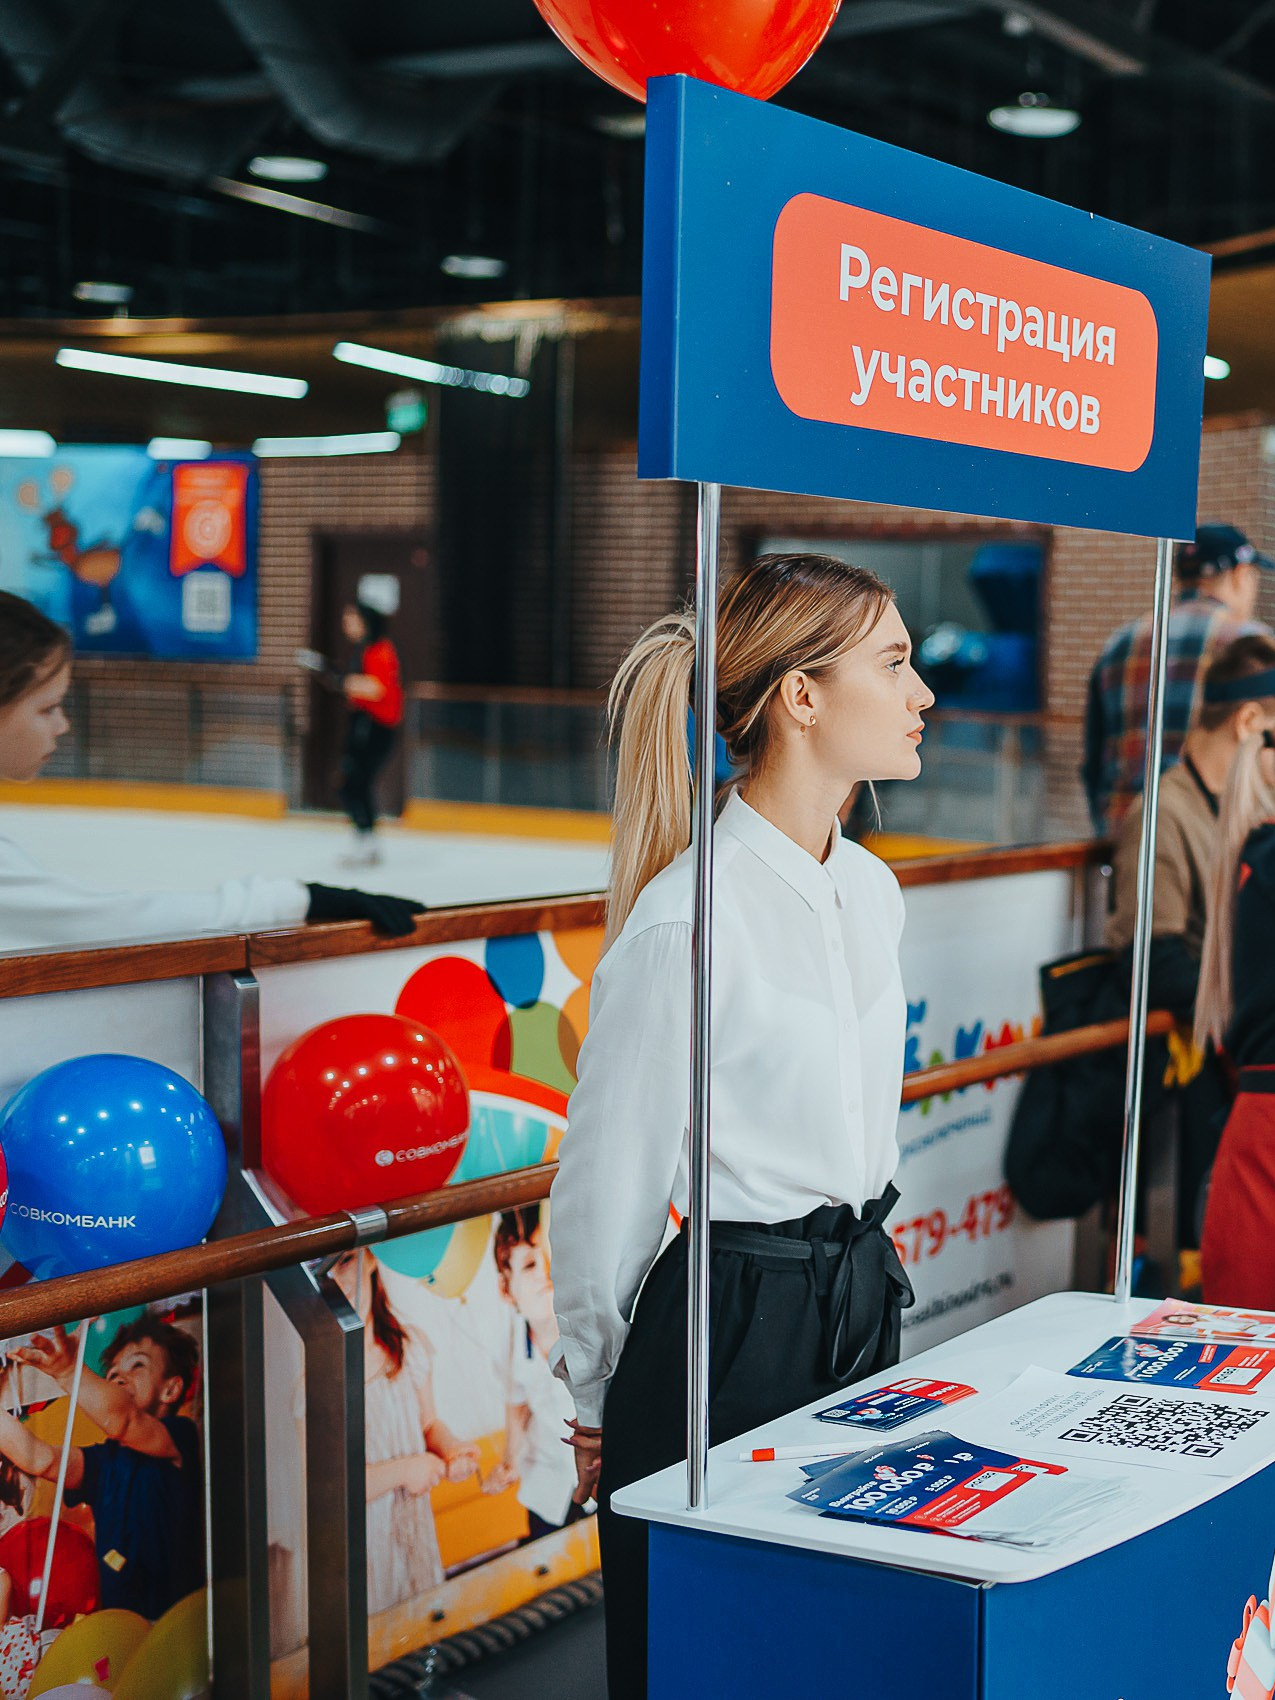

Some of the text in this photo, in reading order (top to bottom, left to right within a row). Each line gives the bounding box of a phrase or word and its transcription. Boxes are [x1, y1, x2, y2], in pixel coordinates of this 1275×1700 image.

[839, 243, 1117, 365] Регистрация
[850, 344, 1101, 435] участников
[9, 1202, 136, 1228] СОВКОМБАНК
